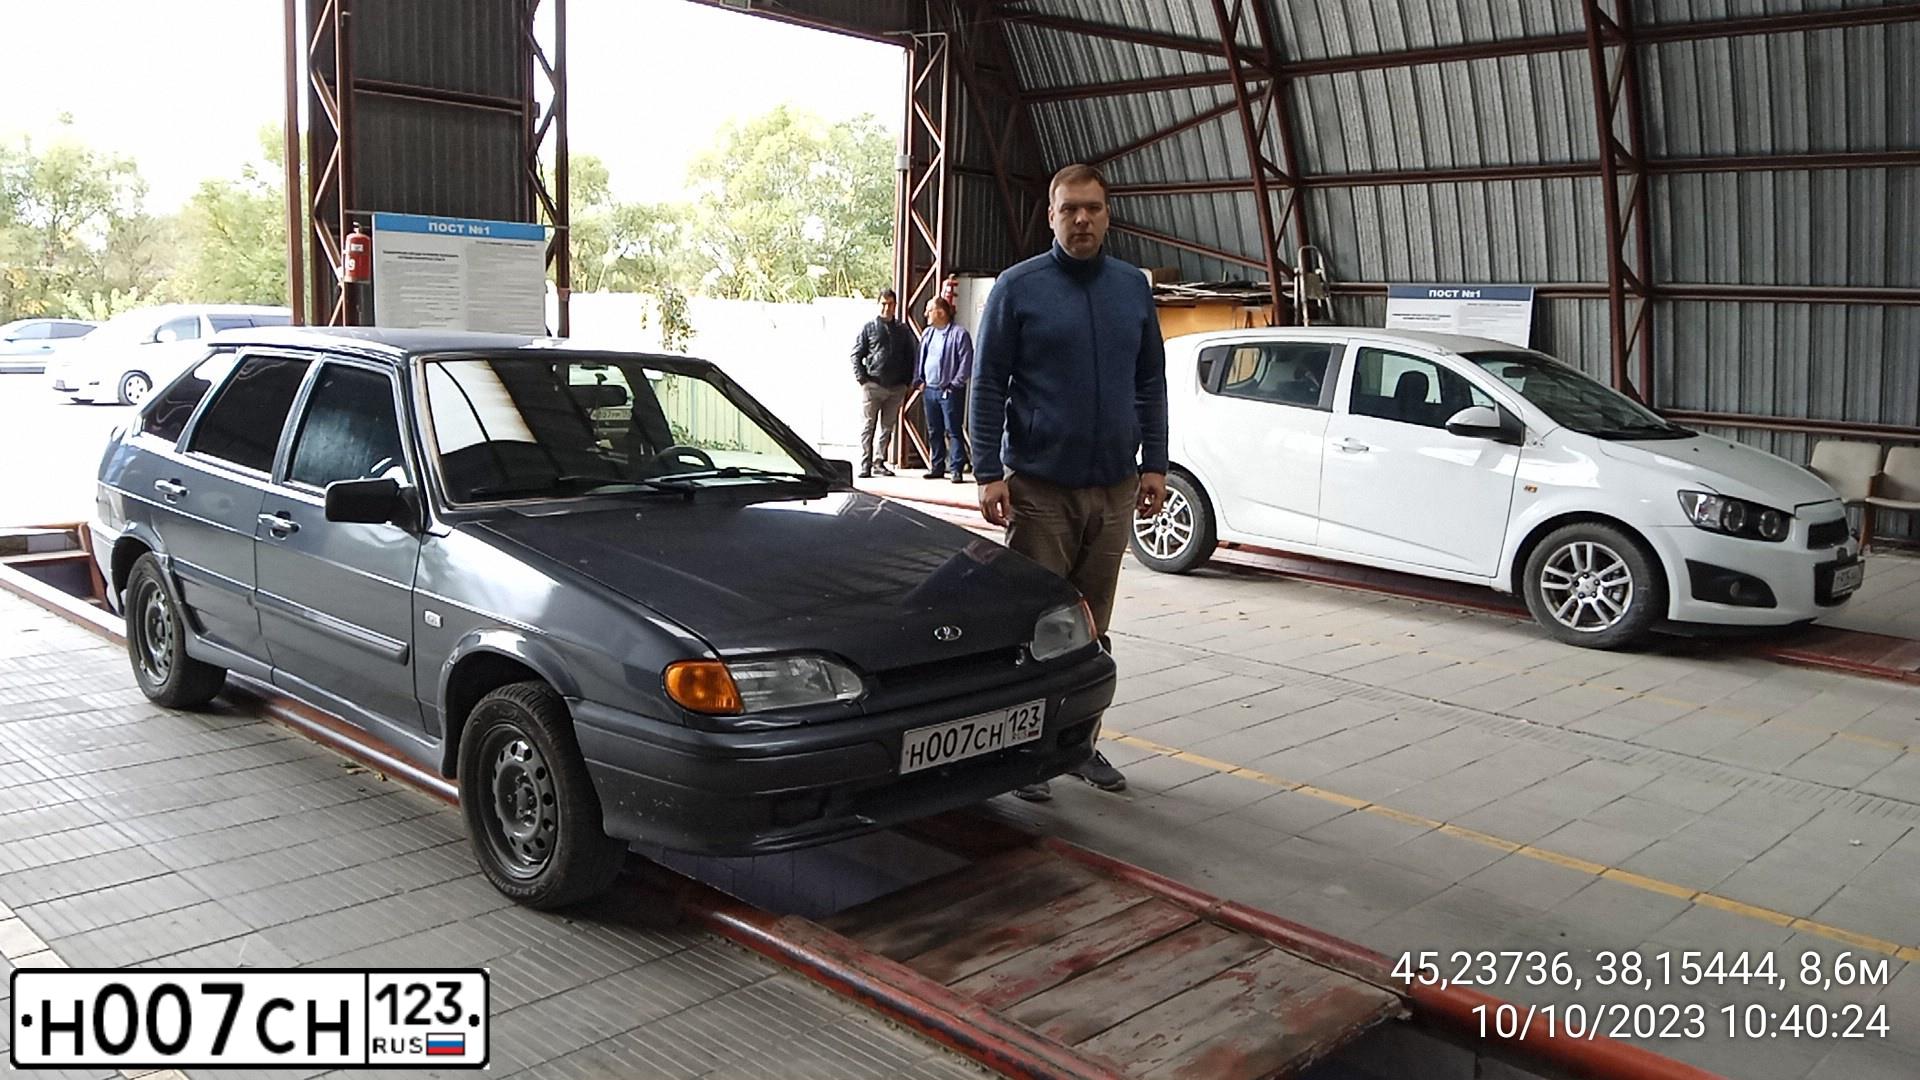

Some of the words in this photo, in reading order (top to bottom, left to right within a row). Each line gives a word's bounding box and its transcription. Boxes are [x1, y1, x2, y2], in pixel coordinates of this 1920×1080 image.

[428, 222, 464, 234] ПОСТ
[468, 224, 490, 235] №1
[1428, 289, 1459, 298] ПОСТ
[1008, 705, 1040, 732] 123
